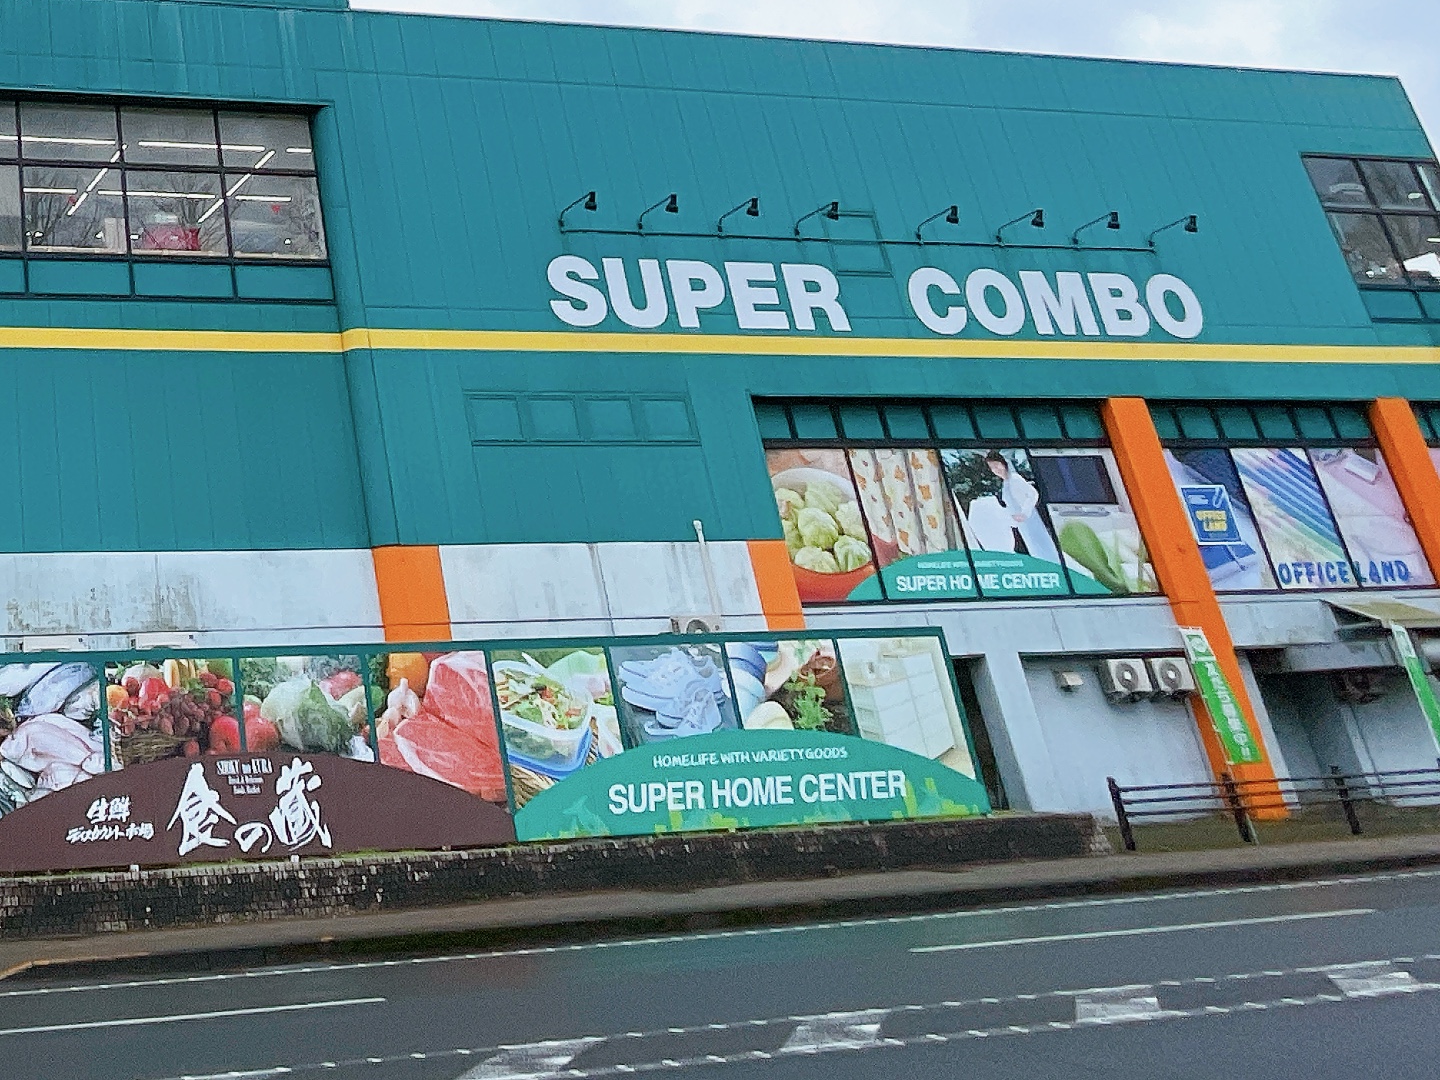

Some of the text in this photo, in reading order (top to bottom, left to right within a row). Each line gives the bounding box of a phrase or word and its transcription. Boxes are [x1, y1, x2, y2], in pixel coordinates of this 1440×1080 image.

[545, 254, 1204, 340] SUPER COMBO
[896, 575, 948, 593] SUPER
[1003, 572, 1061, 590] CENTER
[1277, 559, 1410, 586] OFFICE LAND
[653, 746, 848, 769] HOMELIFE WITH VARIETY GOODS
[166, 757, 333, 857] 食の蔵
[608, 770, 908, 815] SUPER HOME CENTER
[86, 795, 131, 824] 生鮮
